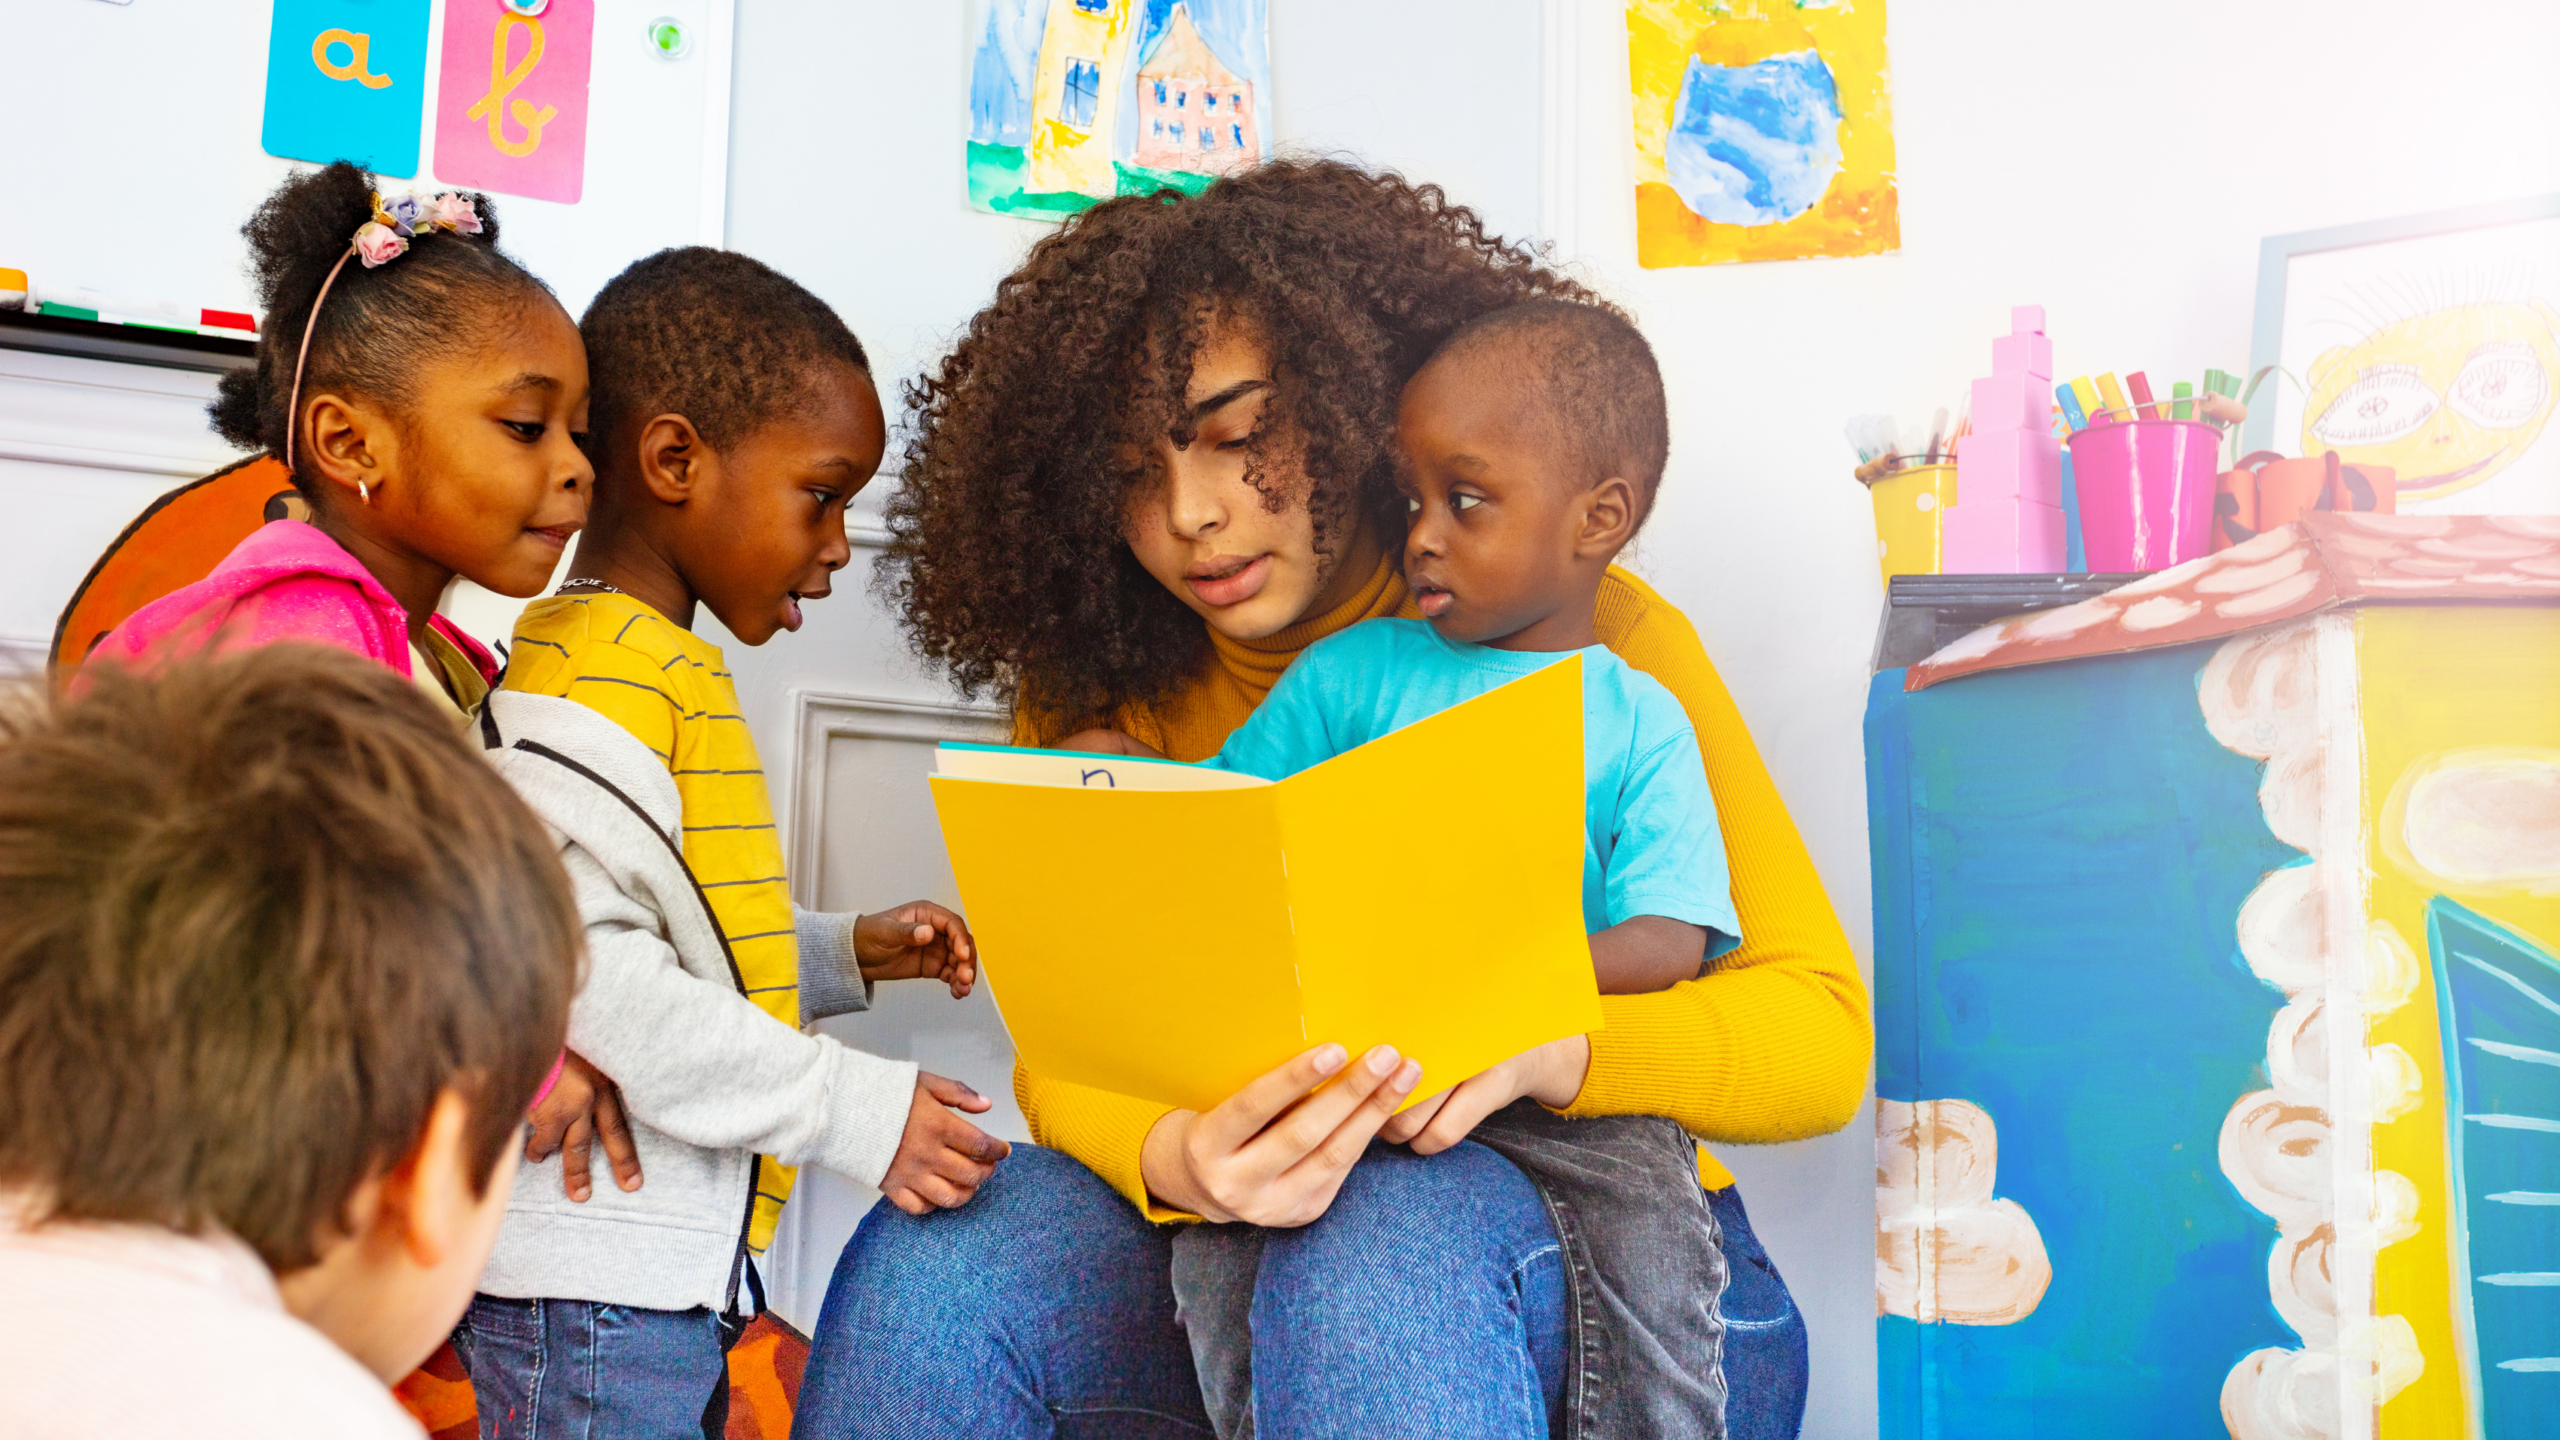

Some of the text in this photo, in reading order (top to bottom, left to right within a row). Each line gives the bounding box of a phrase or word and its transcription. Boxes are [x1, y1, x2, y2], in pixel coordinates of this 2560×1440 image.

[311, 27, 394, 90] a
[465, 9, 559, 158] b
[2051, 412, 2067, 438] 2
[1081, 768, 1116, 788] n
